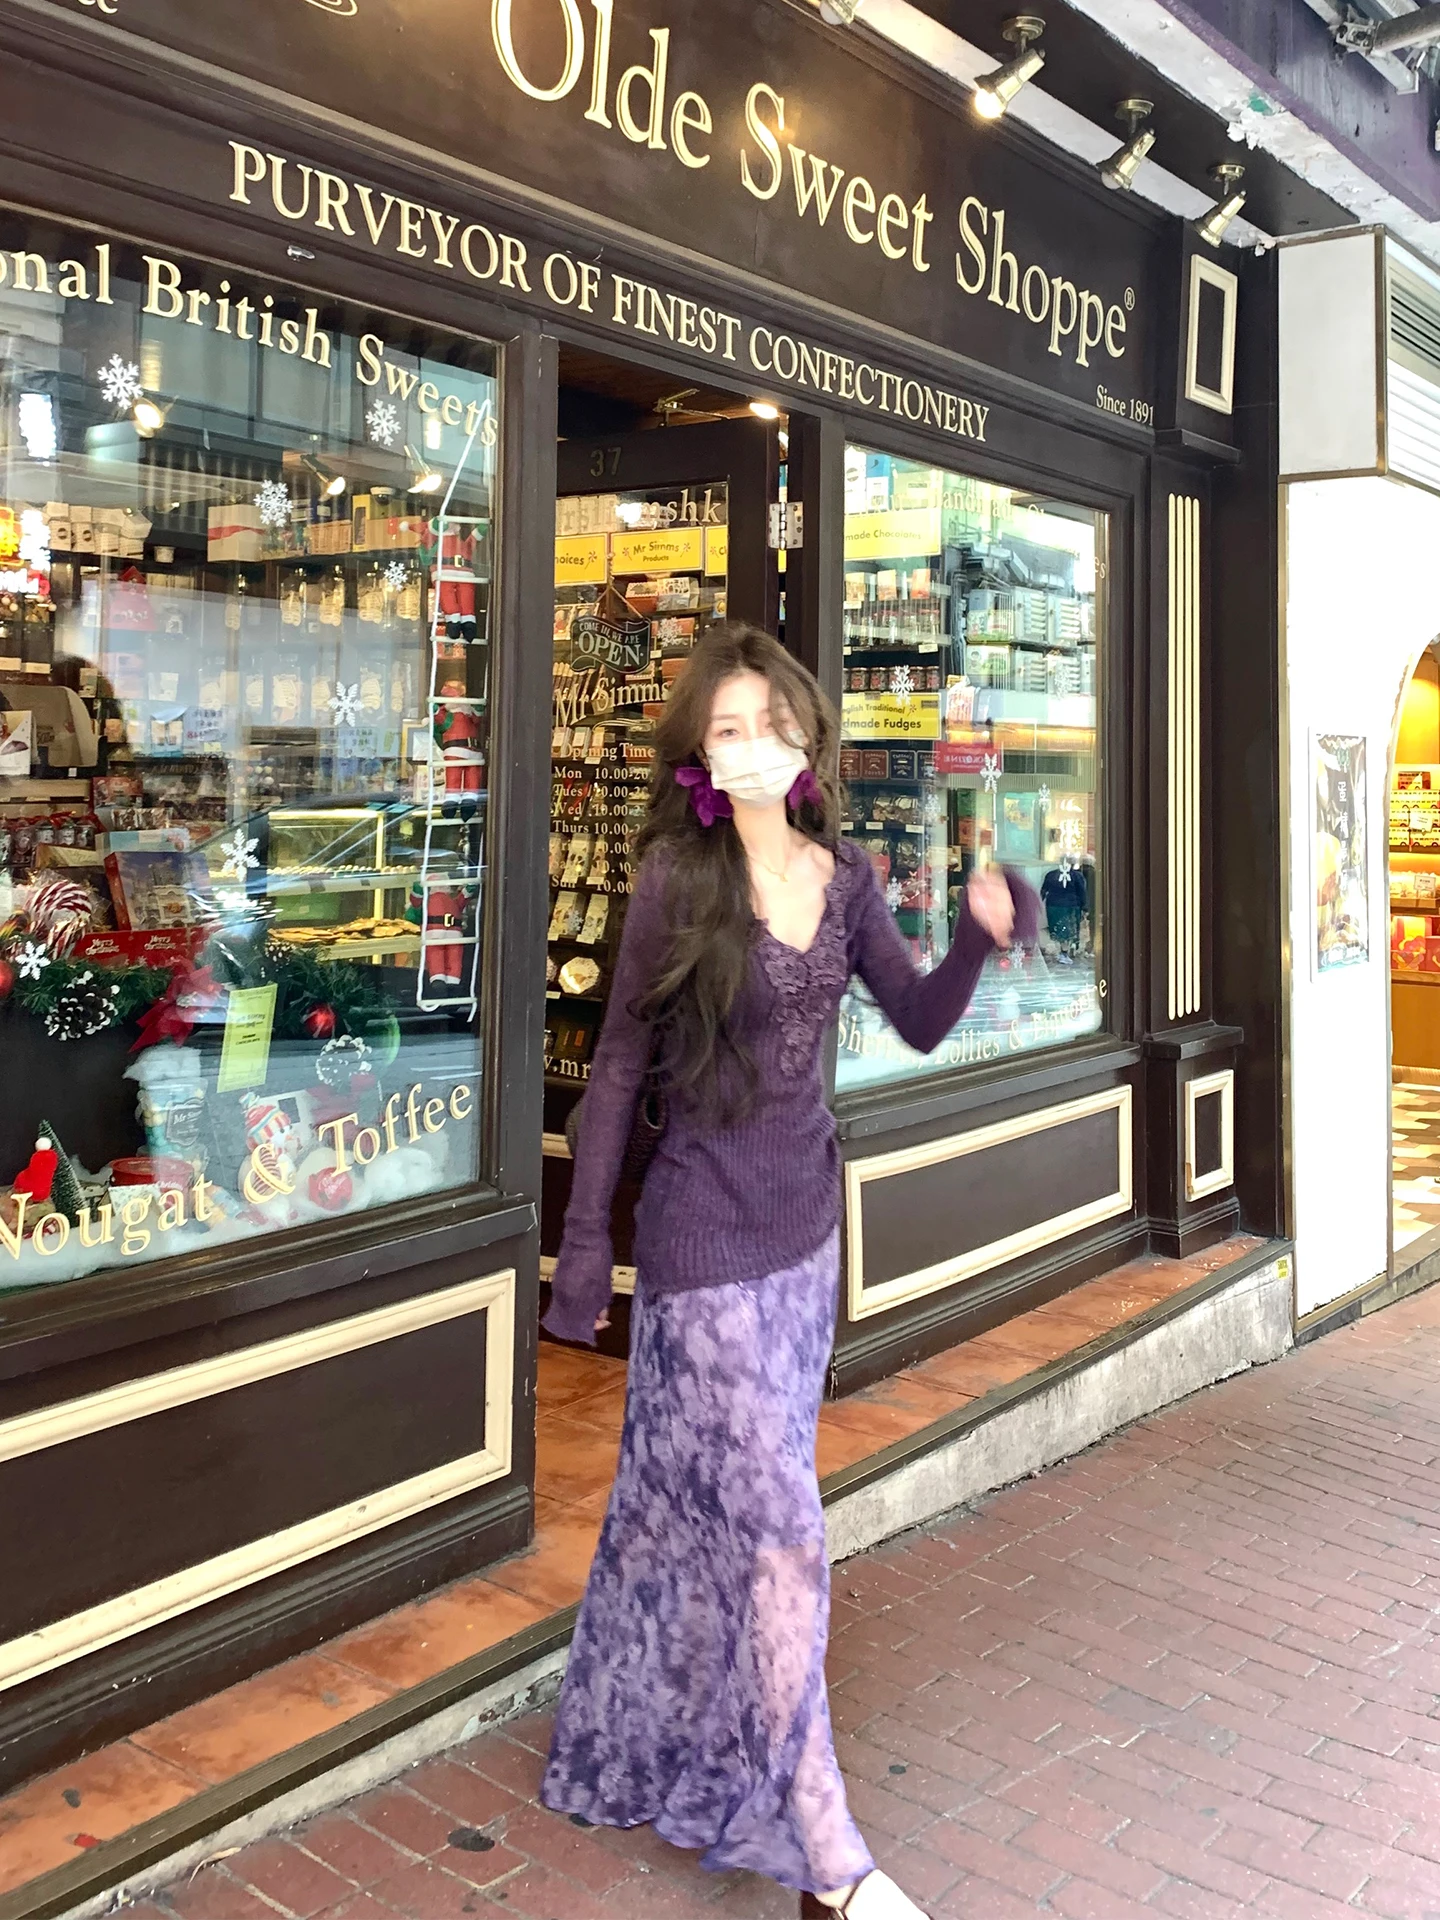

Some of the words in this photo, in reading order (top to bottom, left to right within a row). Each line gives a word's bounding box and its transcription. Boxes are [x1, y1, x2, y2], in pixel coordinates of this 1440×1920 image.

[490, 0, 713, 169] Olde
[740, 82, 934, 272] Sweet
[228, 140, 532, 294] PURVEYOR
[542, 252, 602, 314] OF
[610, 273, 742, 361] FINEST
[749, 326, 990, 443] CONFECTIONERY
[142, 253, 333, 369] British
[355, 332, 498, 448] Sweets
[1095, 384, 1126, 416] Since
[1129, 398, 1154, 427] 1891
[589, 446, 622, 477] 37
[632, 545, 645, 555] Mr
[648, 541, 680, 554] Simms
[579, 622, 600, 632] COME
[612, 631, 623, 643] WE
[624, 634, 640, 644] ARE
[578, 631, 642, 667] OPEN
[554, 683, 590, 727] Mr
[591, 677, 671, 712] Simms
[865, 704, 906, 715] Traditional
[883, 718, 922, 731] Fudges
[553, 766, 583, 779] Mon
[552, 783, 583, 797] Tues
[553, 802, 583, 815] Wed
[552, 820, 590, 833] Thurs
[1008, 1019, 1025, 1051] &
[0, 1172, 213, 1261] Nougat
[243, 1142, 296, 1205] &
[317, 1082, 473, 1179] Toffee
